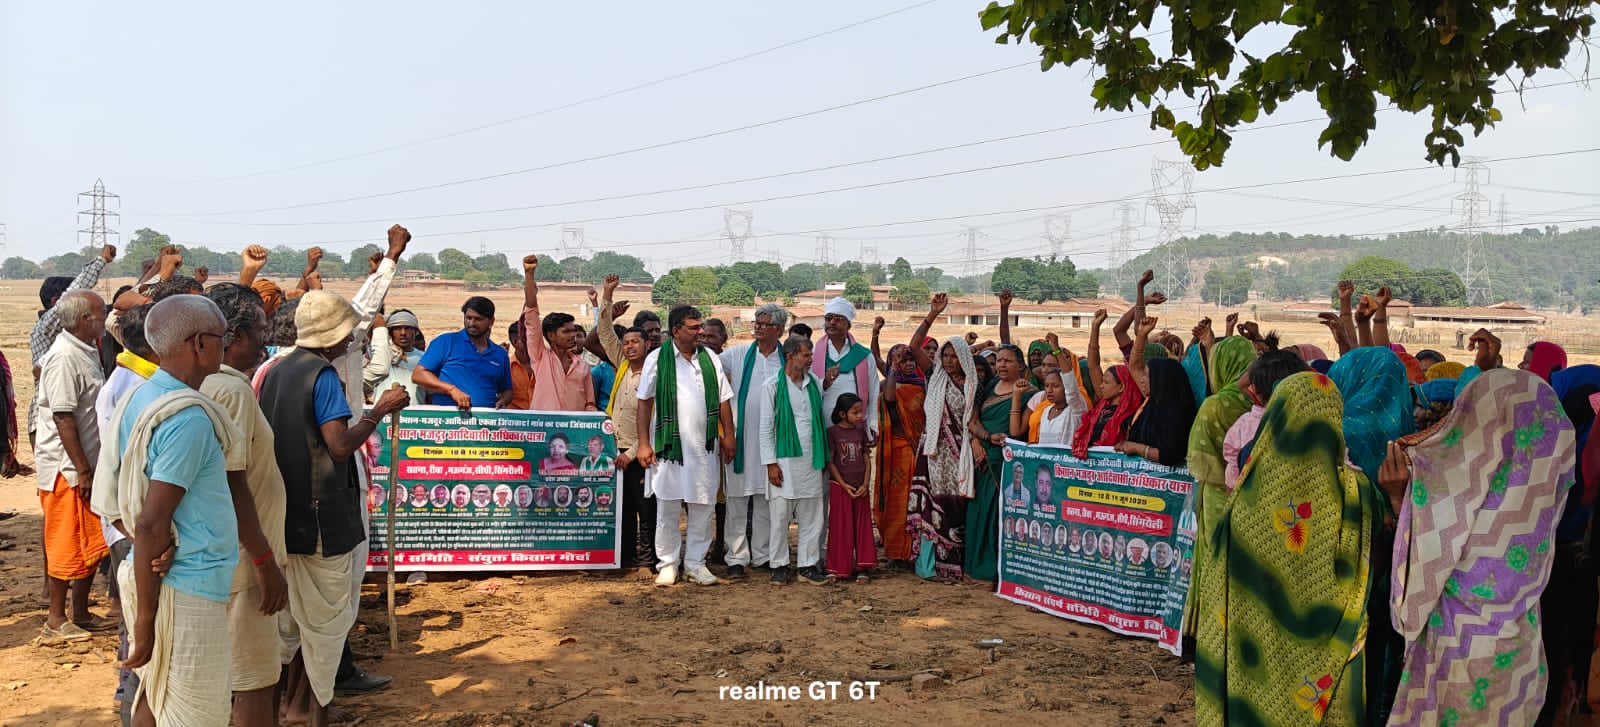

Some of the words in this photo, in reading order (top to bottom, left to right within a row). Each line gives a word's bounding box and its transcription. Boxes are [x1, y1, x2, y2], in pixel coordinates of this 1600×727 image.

[419, 428, 446, 444] मजदूर
[448, 427, 489, 441] आदिवासी
[490, 428, 525, 442] अधिकार
[526, 430, 546, 442] यात्रा
[1054, 463, 1074, 479] किसान
[1075, 468, 1095, 485] मजदूर
[1096, 469, 1129, 486] आदिवासी
[1130, 473, 1167, 491] अधिकार
[408, 552, 454, 563] समिति
[468, 552, 507, 565] संयुक्त
[511, 552, 556, 562] किसान
[560, 551, 591, 561] मोर्चा
[1014, 587, 1041, 602] किसान
[1066, 602, 1099, 617] समिति
